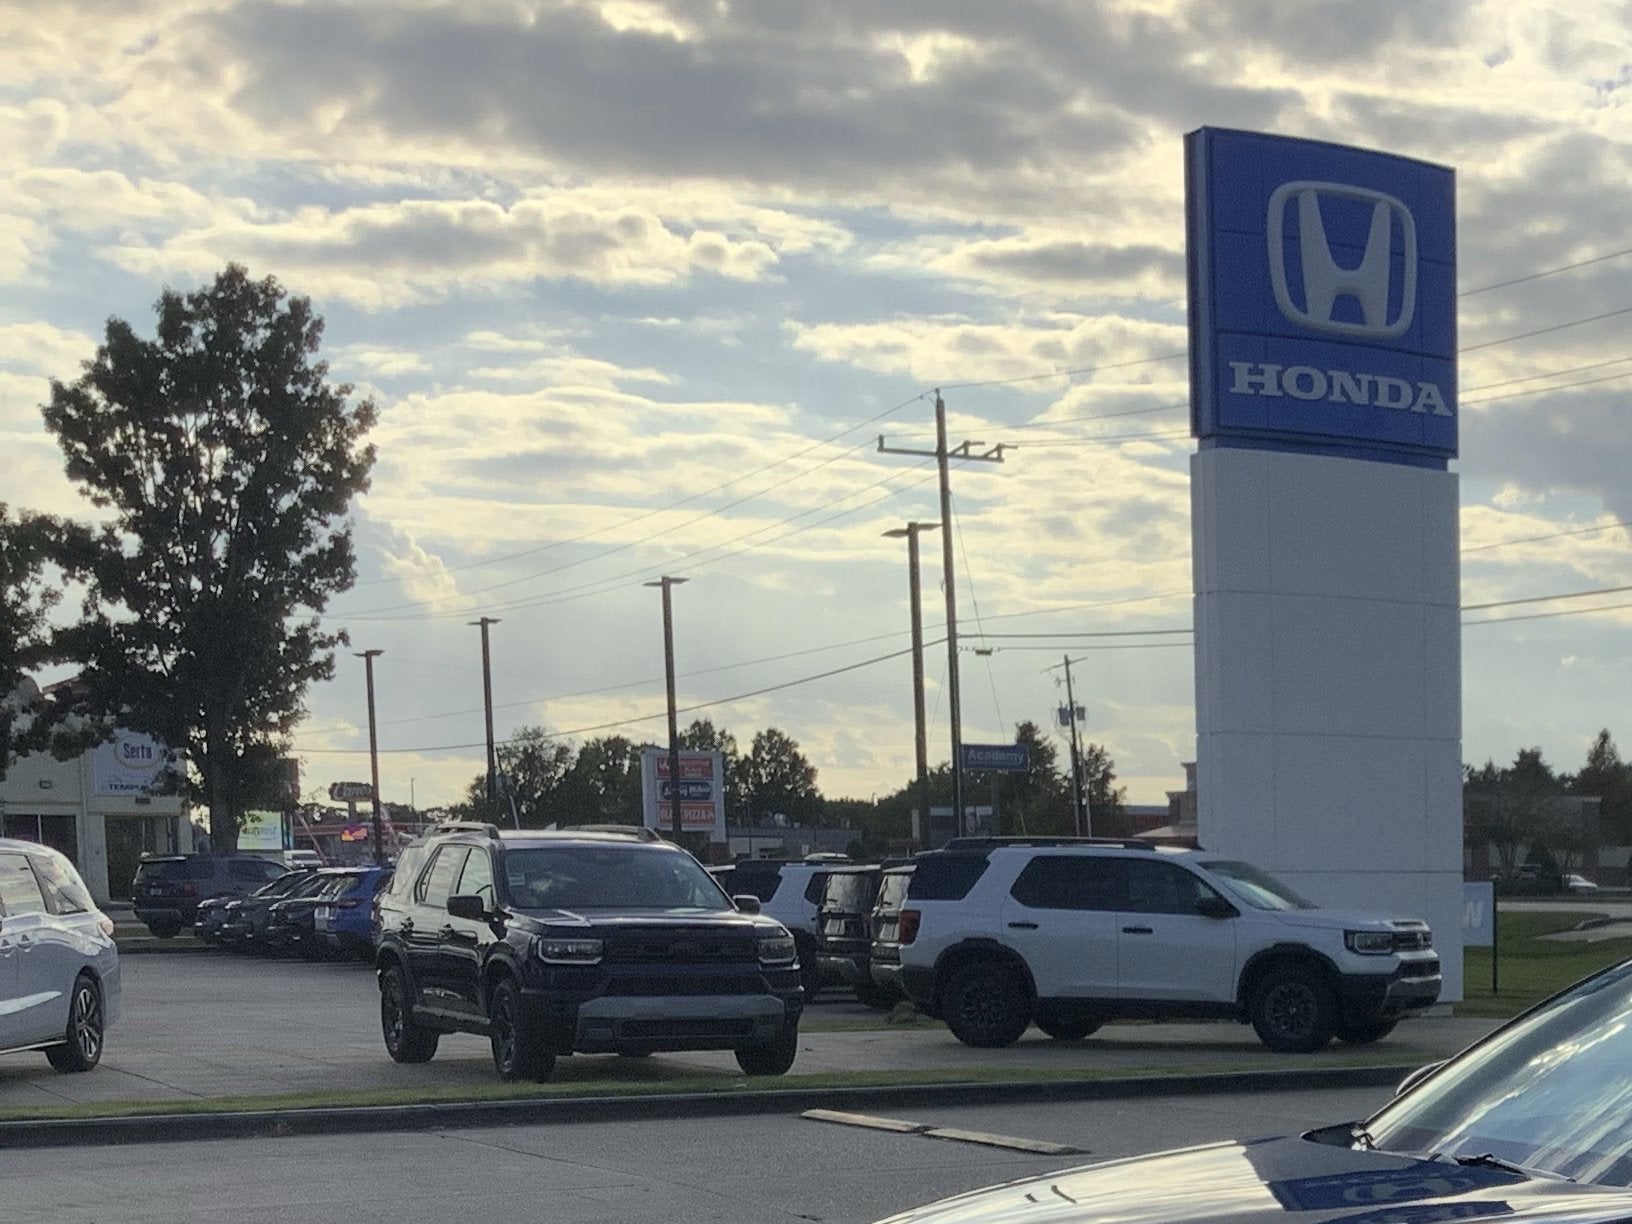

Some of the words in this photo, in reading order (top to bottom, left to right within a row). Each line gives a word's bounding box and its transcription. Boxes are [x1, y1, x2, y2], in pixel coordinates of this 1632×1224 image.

[1229, 361, 1452, 417] HONDA
[123, 742, 153, 760] Serta
[967, 748, 1025, 765] Academy
